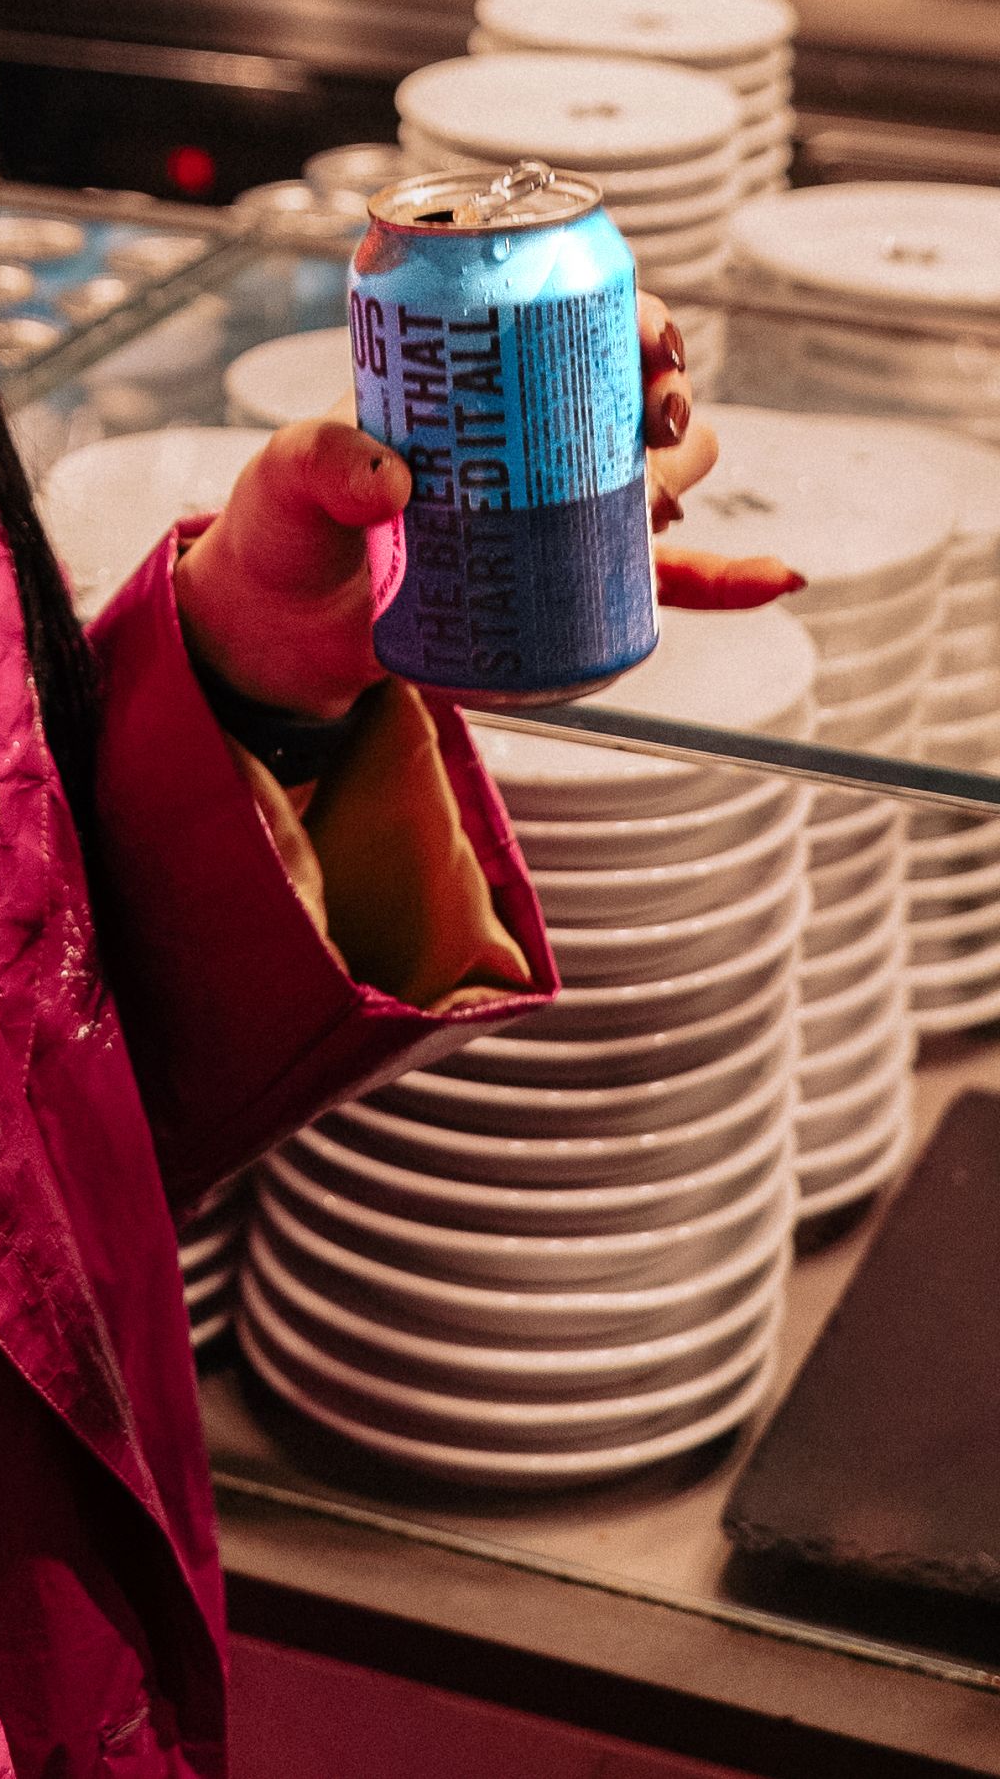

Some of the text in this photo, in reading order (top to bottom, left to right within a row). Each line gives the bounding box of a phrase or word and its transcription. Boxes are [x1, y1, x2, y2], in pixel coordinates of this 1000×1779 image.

[398, 305, 460, 671] THE BEER THAT
[449, 307, 519, 674] STARTED IT ALL
